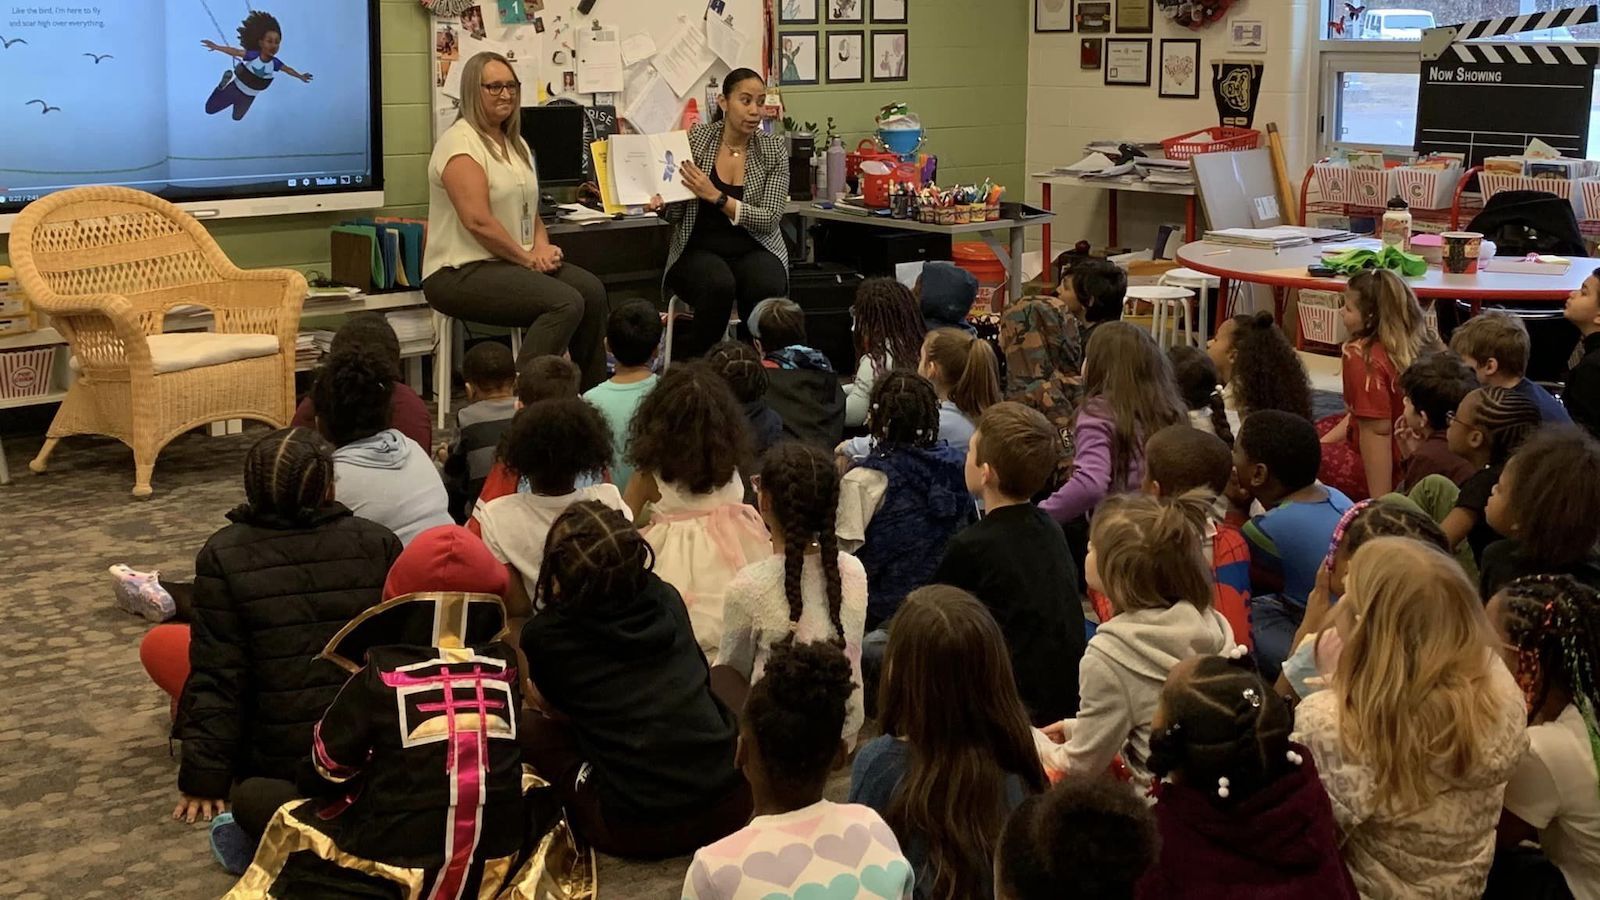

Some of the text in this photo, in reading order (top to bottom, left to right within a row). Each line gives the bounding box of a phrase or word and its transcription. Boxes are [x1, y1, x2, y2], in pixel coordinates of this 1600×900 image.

[512, 1, 518, 14] 1
[37, 20, 51, 28] high
[315, 176, 337, 186] YouTube
[1410, 184, 1422, 197] C
